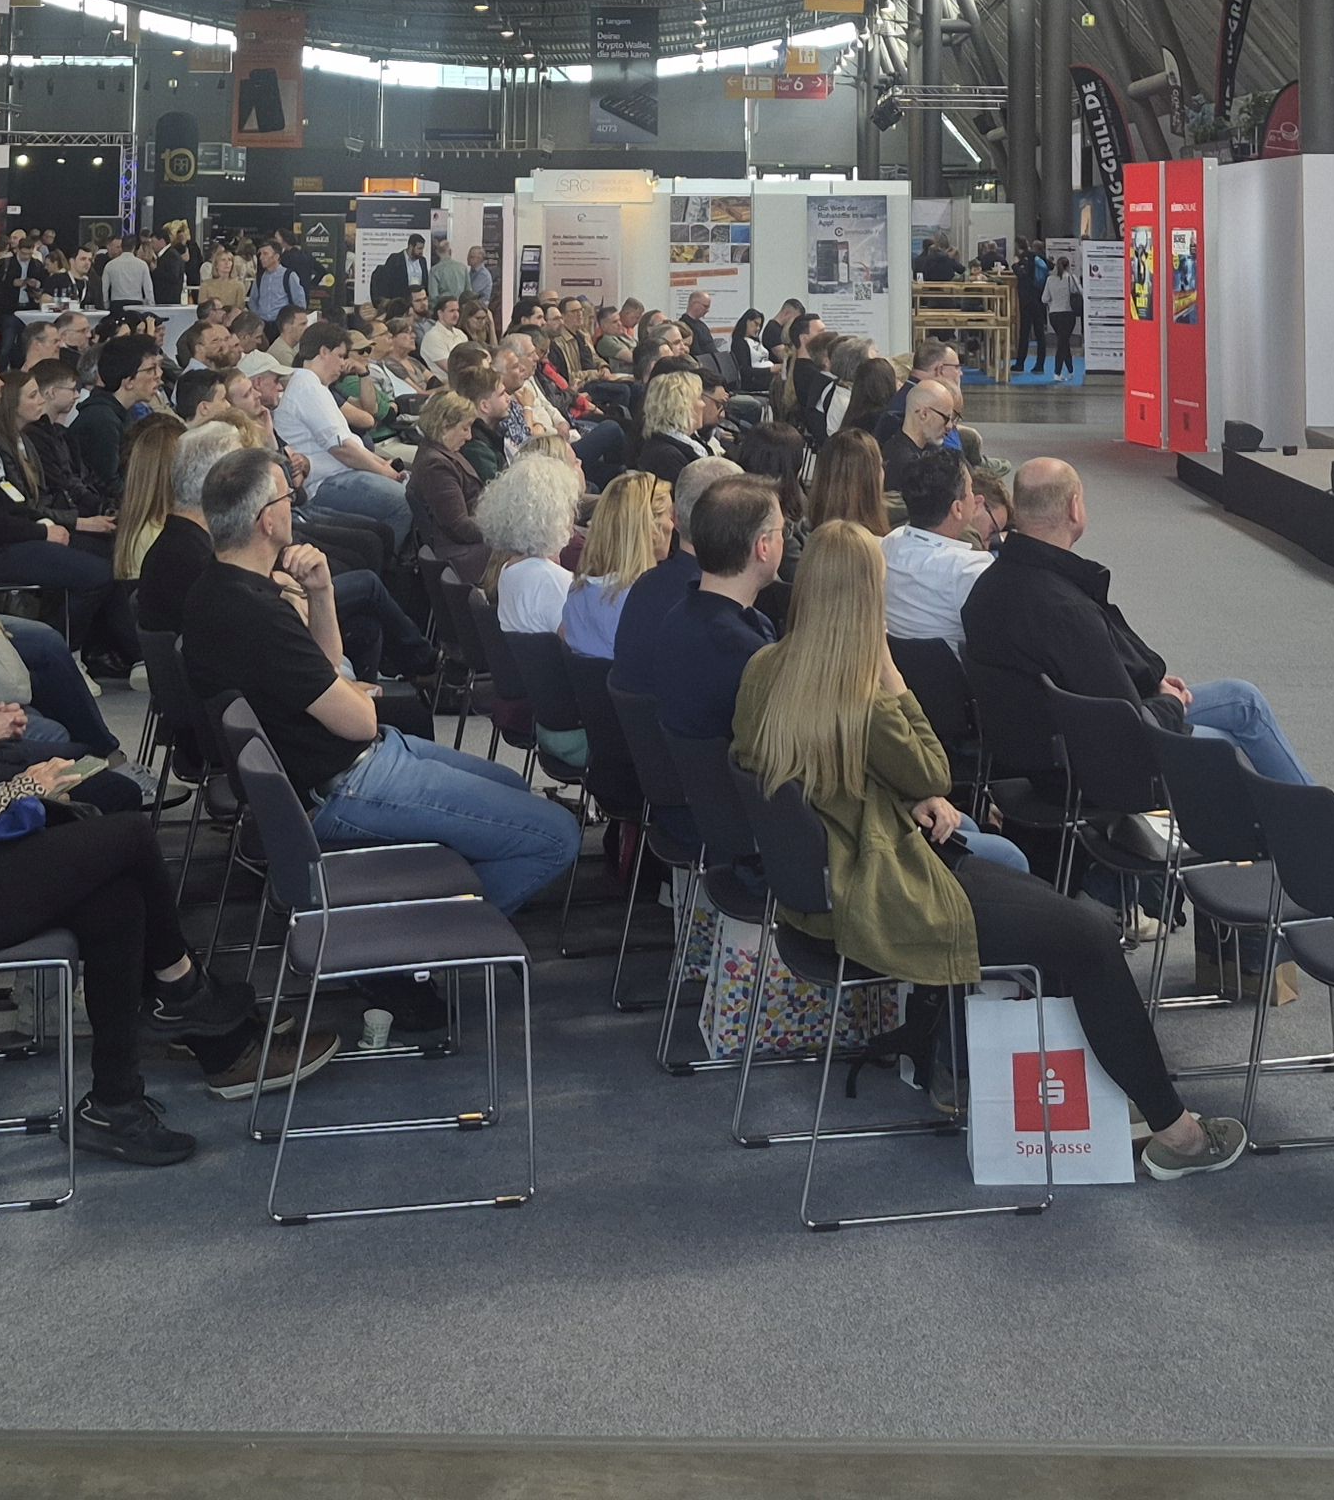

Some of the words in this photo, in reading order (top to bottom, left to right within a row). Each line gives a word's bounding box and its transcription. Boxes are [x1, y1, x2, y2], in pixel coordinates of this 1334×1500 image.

[597, 32, 620, 40] Deine
[597, 42, 624, 51] Krypto
[597, 50, 609, 58] die
[611, 50, 629, 58] alles
[630, 50, 649, 58] kann
[1016, 1141, 1092, 1158] Spakasse
